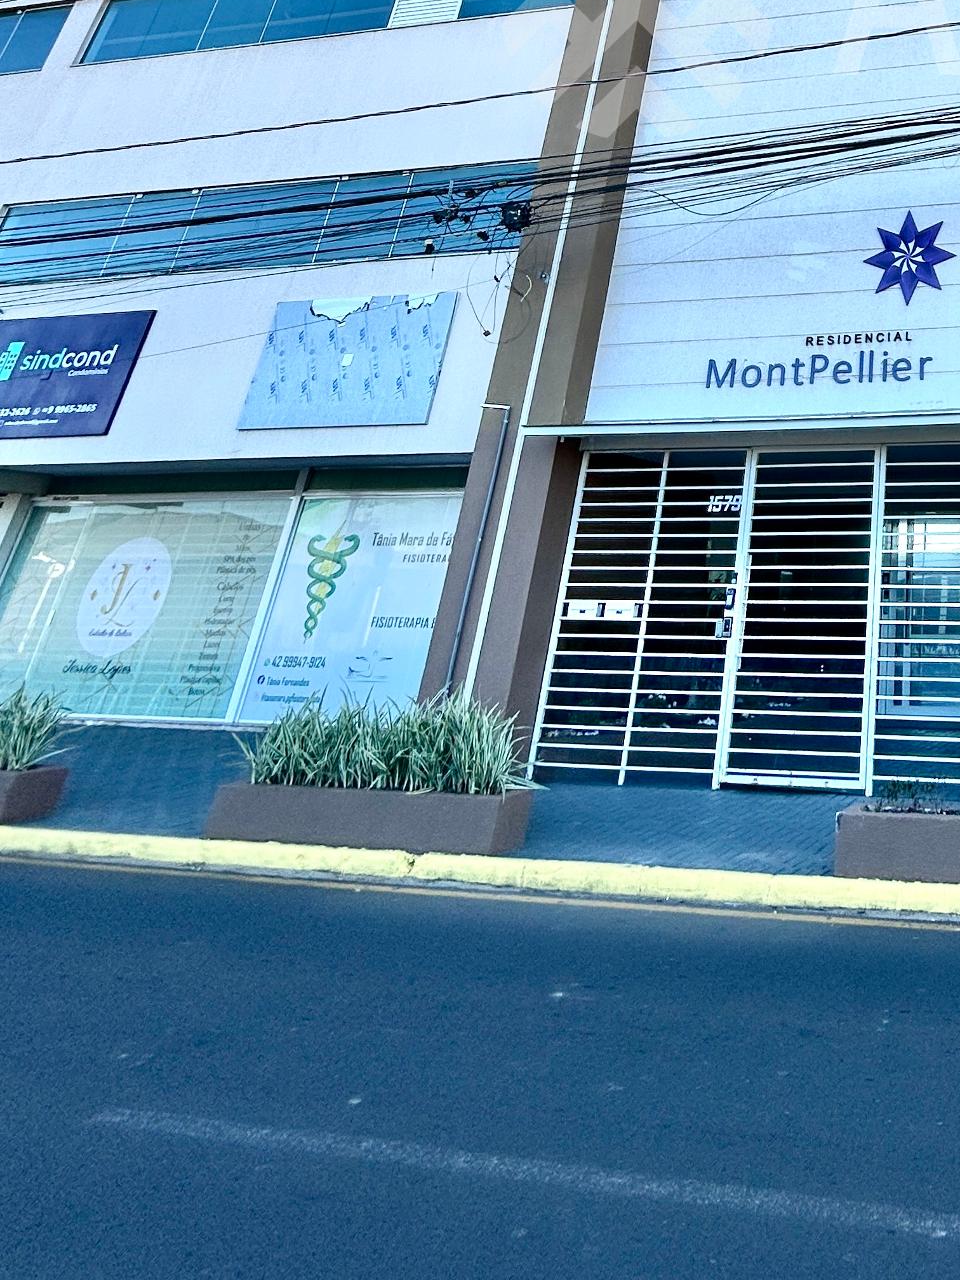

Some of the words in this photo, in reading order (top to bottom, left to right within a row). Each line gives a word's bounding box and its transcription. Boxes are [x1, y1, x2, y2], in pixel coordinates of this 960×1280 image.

[805, 331, 913, 346] RESIDENCIAL
[20, 344, 119, 370] sindcond
[705, 350, 933, 388] MontPellier
[707, 495, 743, 513] 1579
[372, 531, 398, 547] Tânia
[399, 531, 424, 547] Mara
[426, 531, 439, 547] de
[440, 531, 455, 547] Fá
[371, 616, 430, 629] FISIOTERAPIA
[271, 655, 282, 668] 42
[282, 655, 327, 669] 99947-9124
